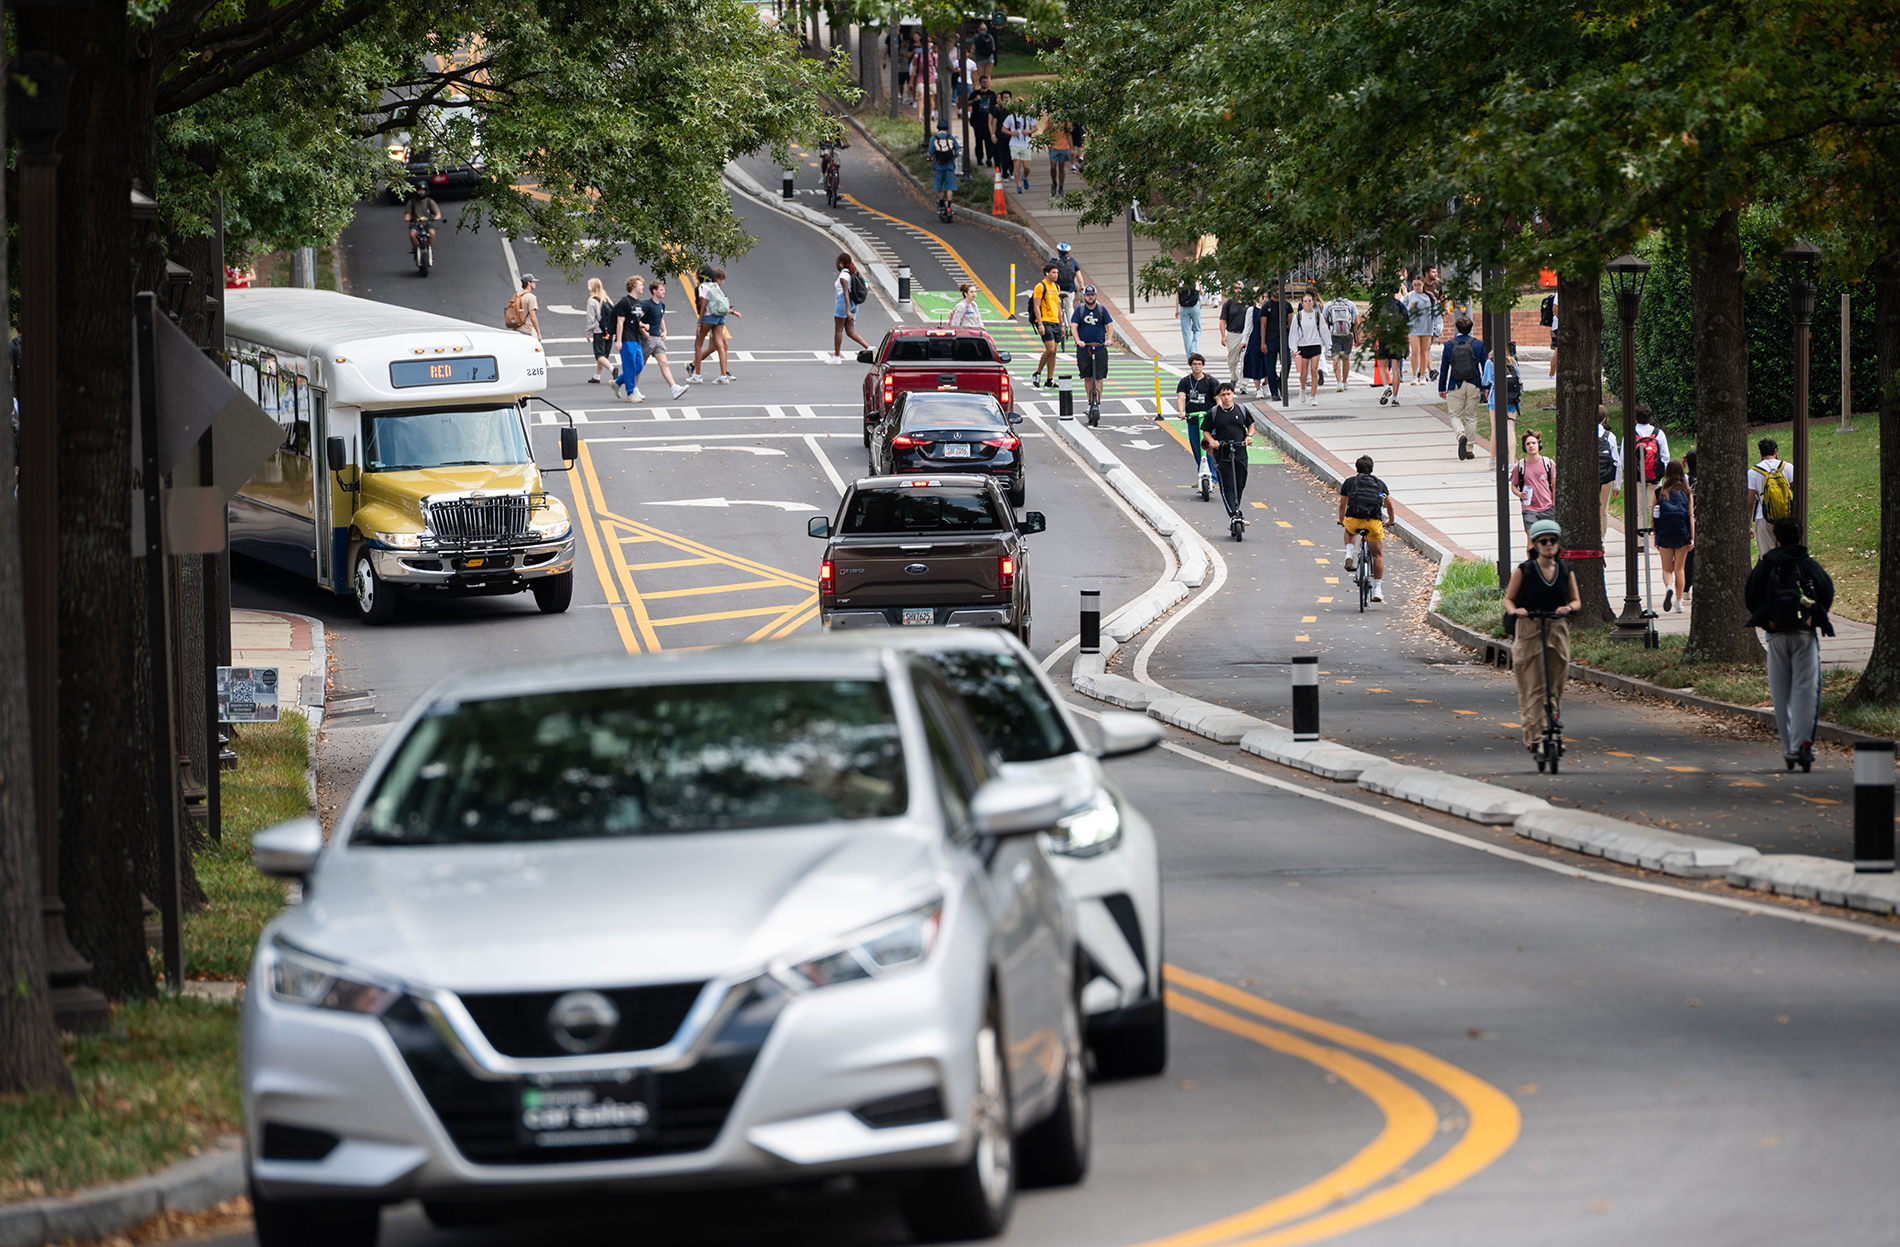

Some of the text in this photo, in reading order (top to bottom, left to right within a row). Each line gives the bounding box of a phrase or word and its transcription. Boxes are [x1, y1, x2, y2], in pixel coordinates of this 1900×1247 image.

[430, 364, 452, 379] RED
[526, 367, 544, 376] 2216
[905, 612, 931, 620] SHV7625
